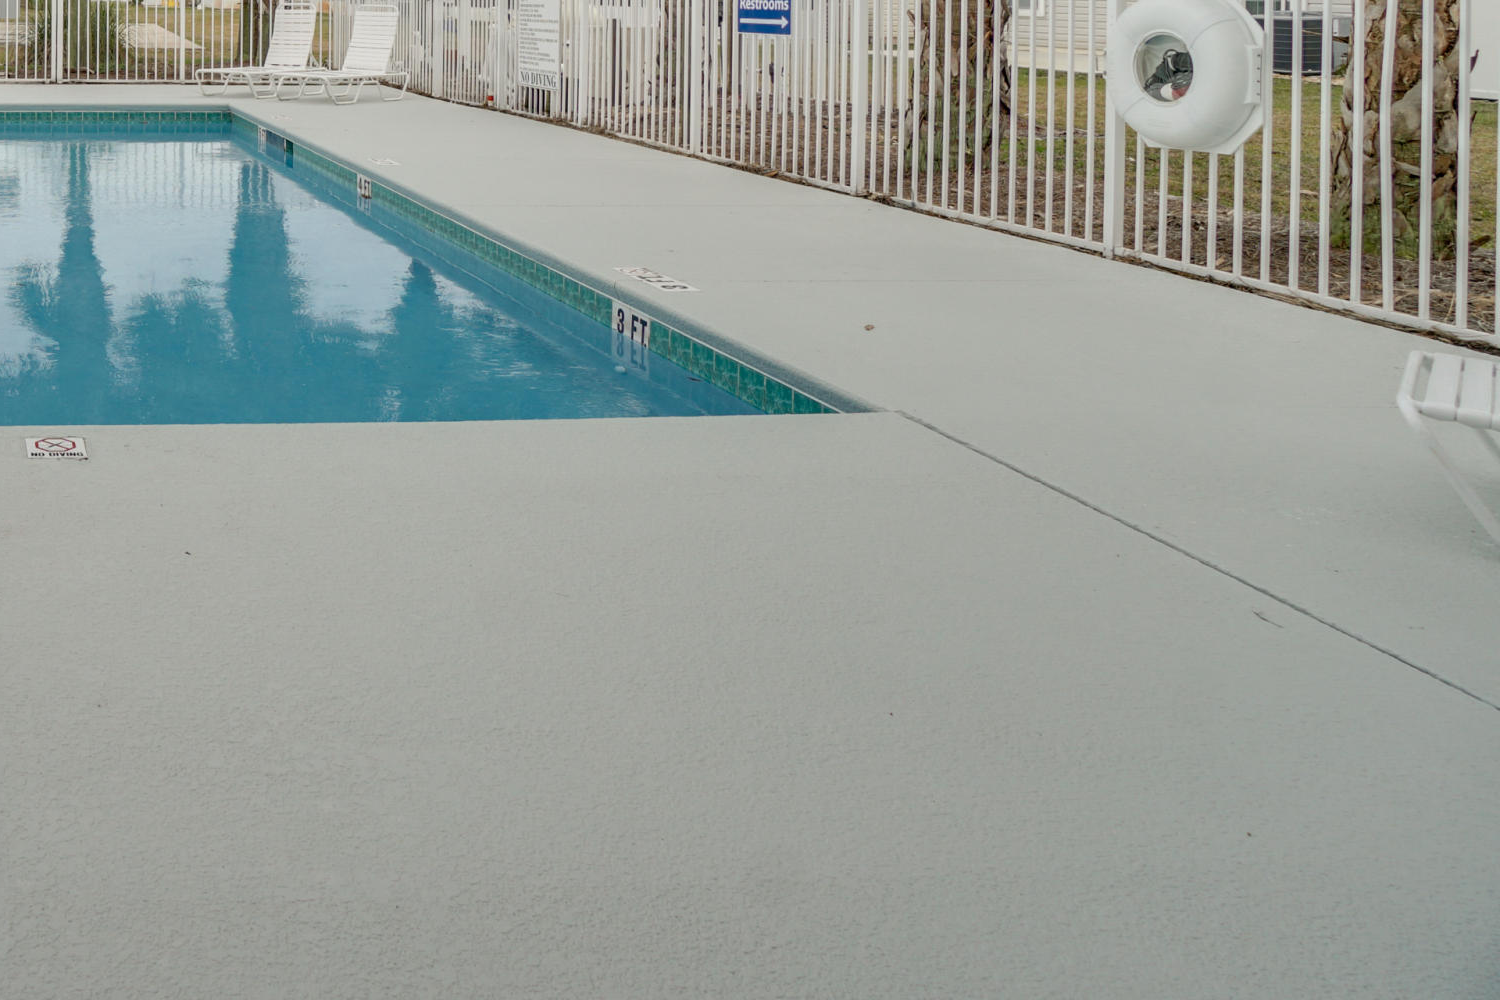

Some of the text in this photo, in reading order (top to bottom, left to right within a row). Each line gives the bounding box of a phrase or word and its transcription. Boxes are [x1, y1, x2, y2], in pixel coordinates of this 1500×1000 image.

[520, 71, 557, 88] NO DIVING
[617, 307, 625, 334] 3
